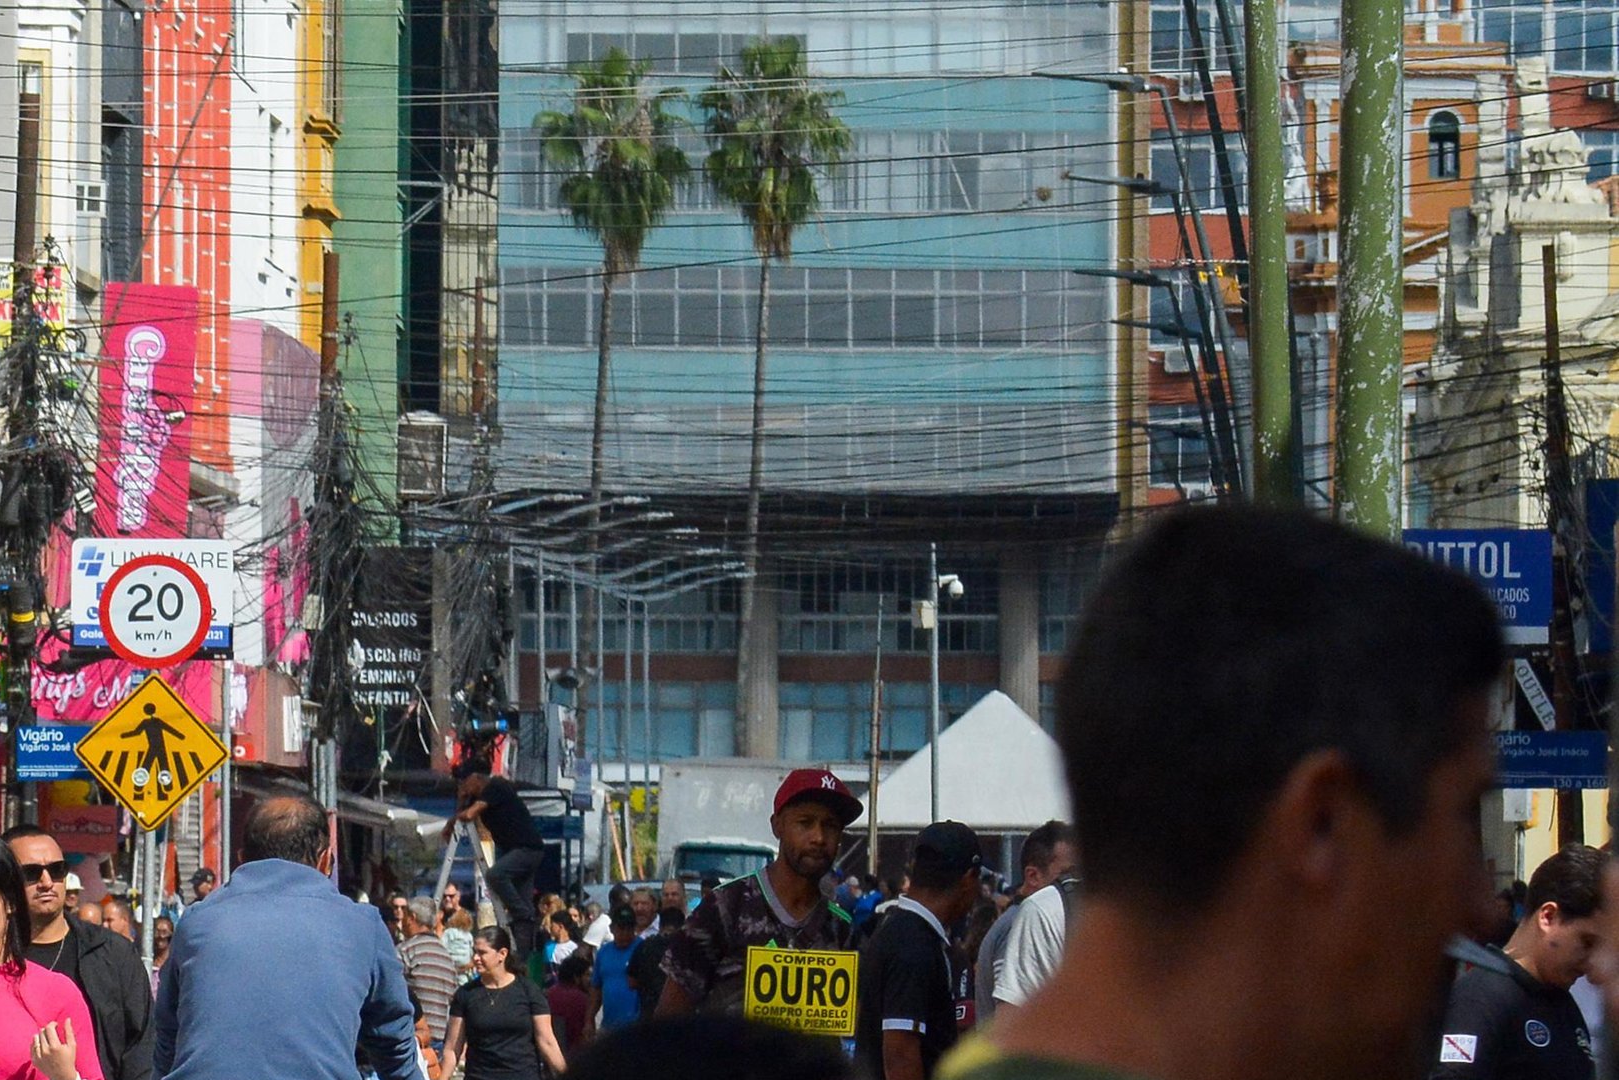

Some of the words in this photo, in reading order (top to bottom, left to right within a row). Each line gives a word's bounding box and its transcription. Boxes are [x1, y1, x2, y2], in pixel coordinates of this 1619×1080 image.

[127, 329, 161, 410] Cara
[126, 582, 185, 622] 20
[135, 629, 172, 641] km/h
[19, 727, 64, 745] Vigário
[19, 742, 50, 753] Vigário
[51, 742, 71, 752] José
[773, 954, 837, 967] COMPRO
[753, 963, 851, 1008] OURO
[753, 1005, 802, 1017] COMPRO
[805, 1008, 848, 1019] CABELO
[803, 1018, 847, 1030] PIERCING
